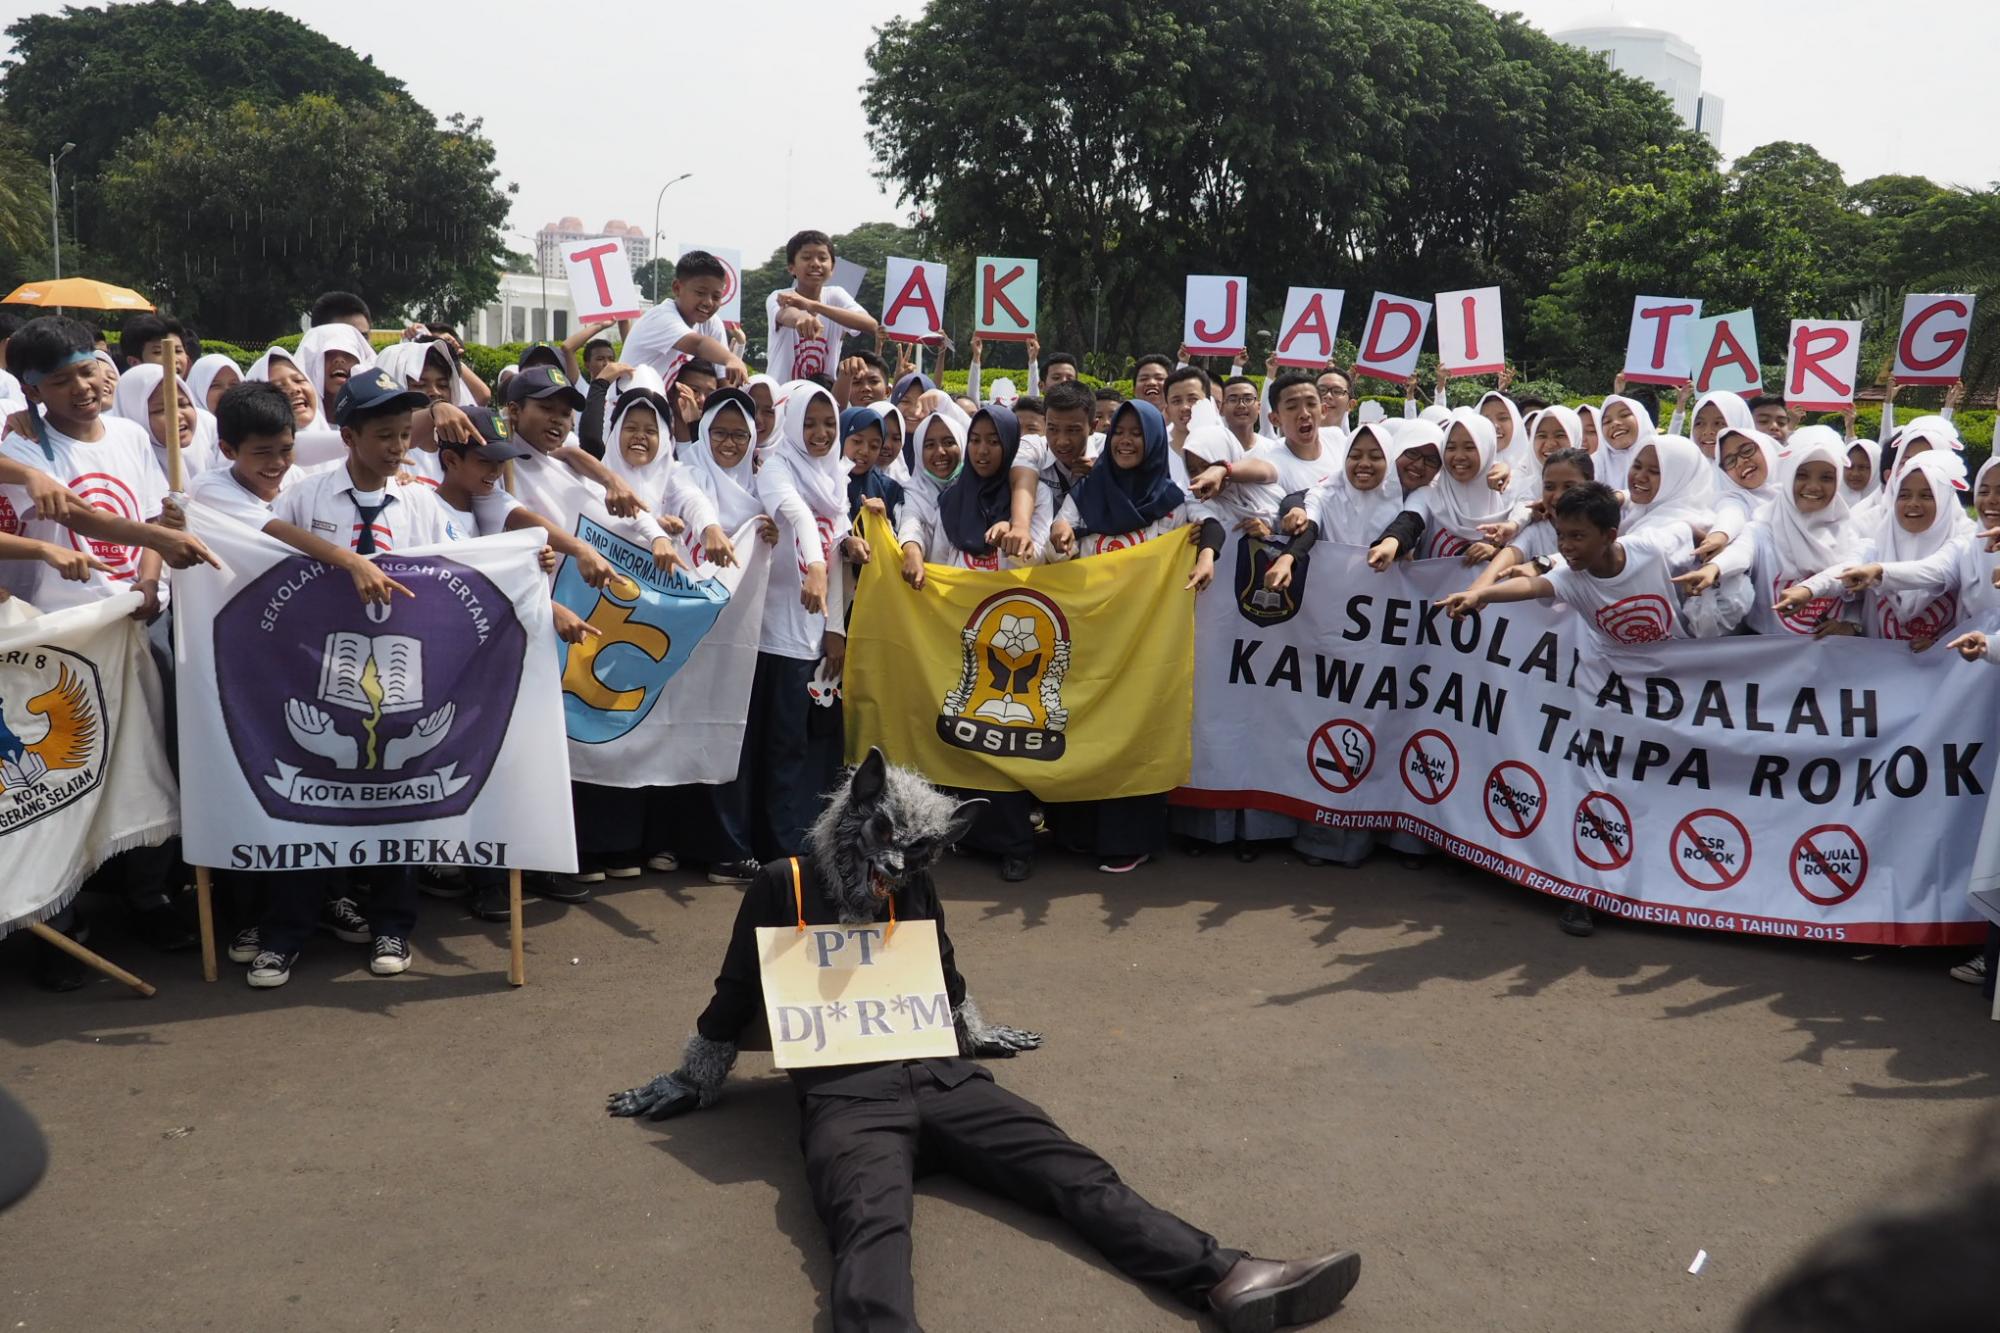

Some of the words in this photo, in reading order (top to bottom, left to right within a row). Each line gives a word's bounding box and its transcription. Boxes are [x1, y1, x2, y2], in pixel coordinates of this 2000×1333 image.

[585, 526, 608, 551] SMP
[261, 561, 325, 632] SEKOLAH
[438, 569, 488, 646] PERTAMA
[35, 654, 47, 669] 8
[1595, 671, 1878, 738] ADALAH
[955, 721, 1042, 751] OSIS
[1229, 639, 1507, 735] KAWASAN
[1537, 703, 1711, 790] TANPA
[1749, 742, 1985, 807] ROKOK
[13, 782, 49, 807] KOTA
[46, 768, 94, 806] SELATAN
[300, 784, 354, 801] KOTA
[360, 784, 435, 801] BEKASI
[231, 841, 338, 869] SMPN
[349, 840, 367, 865] 6
[377, 839, 508, 867] BEKASI
[1698, 836, 1725, 850] CSR
[1315, 809, 1392, 828] PERATURAN
[1397, 816, 1443, 847] MENTERI
[1446, 837, 1524, 881] KEBUDAYAAN
[1527, 872, 1589, 902] REPUBLIK
[1594, 893, 1681, 924] INDONESIA
[1686, 911, 1735, 930] NO.64
[1740, 918, 1798, 937] TAHUN
[1804, 926, 1845, 941] 2015
[814, 930, 880, 967] PT
